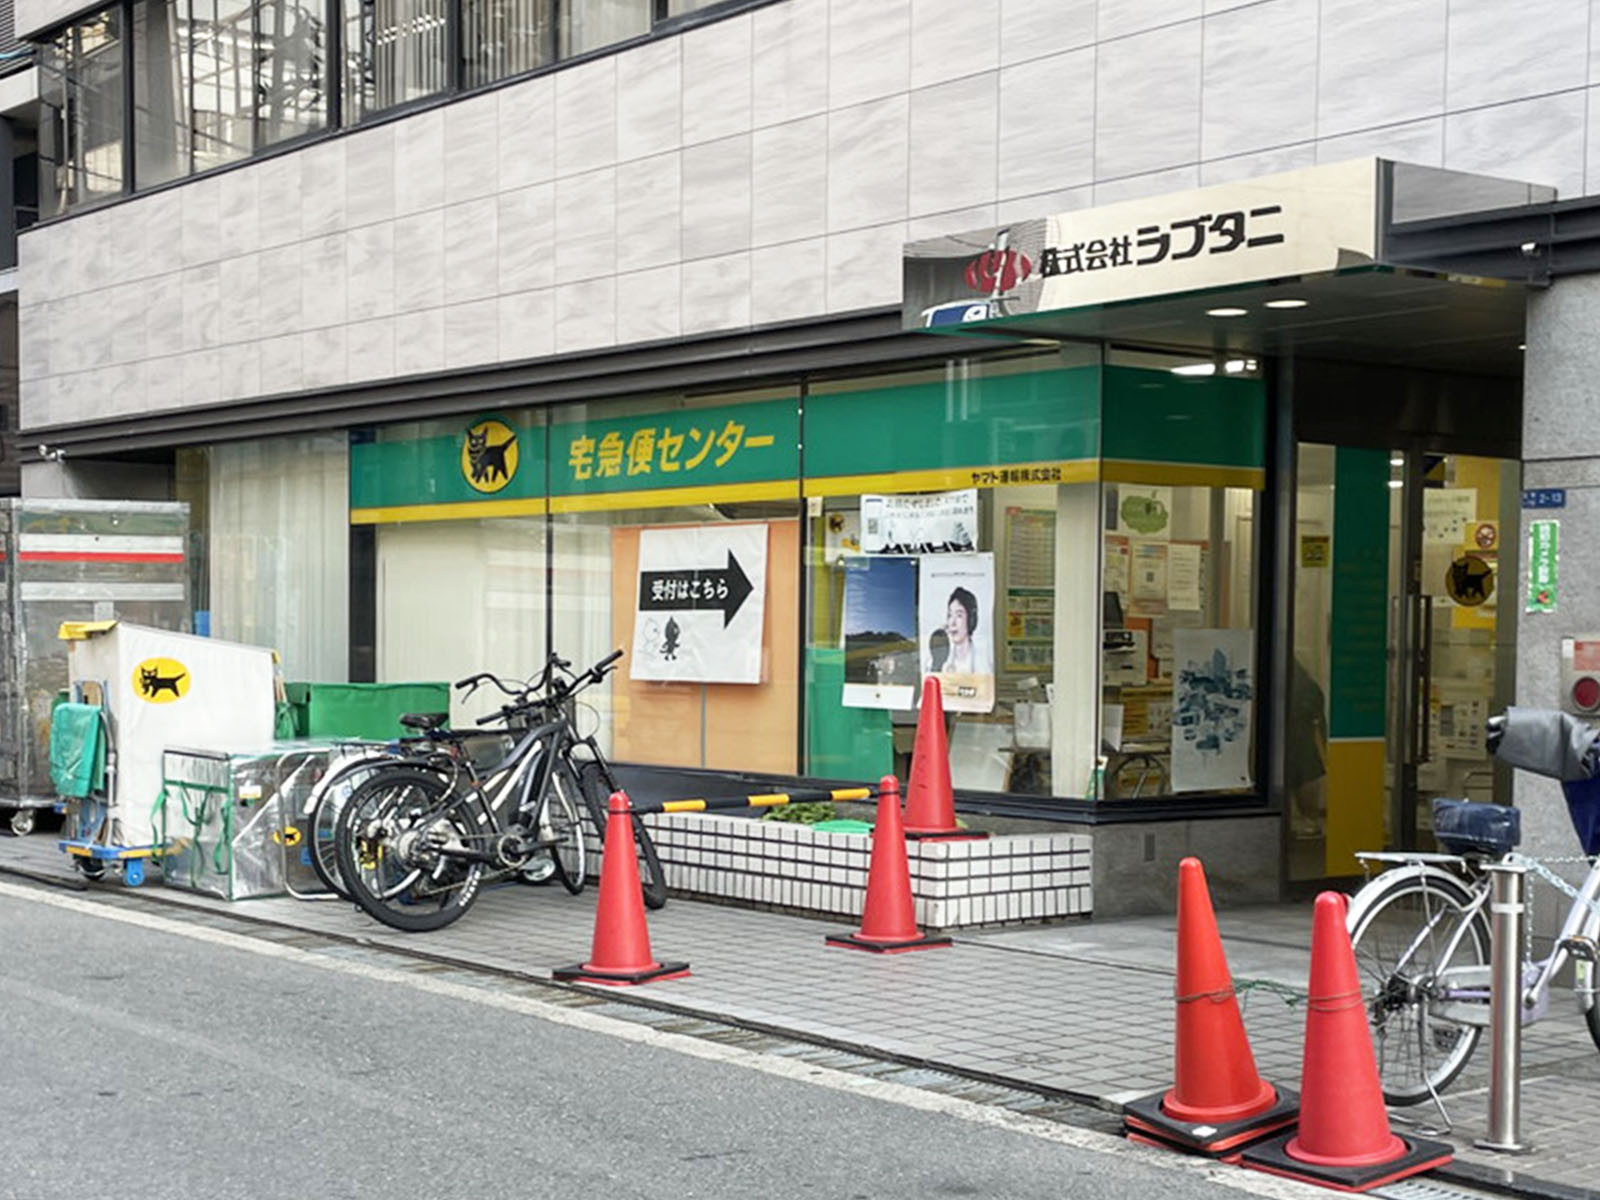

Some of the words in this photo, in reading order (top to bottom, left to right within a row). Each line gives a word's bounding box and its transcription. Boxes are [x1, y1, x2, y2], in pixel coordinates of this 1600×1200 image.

[568, 420, 775, 480] 宅急便センター
[971, 467, 1062, 485] ヤマト運輸株式会社
[651, 578, 729, 601] 受付はこちら
